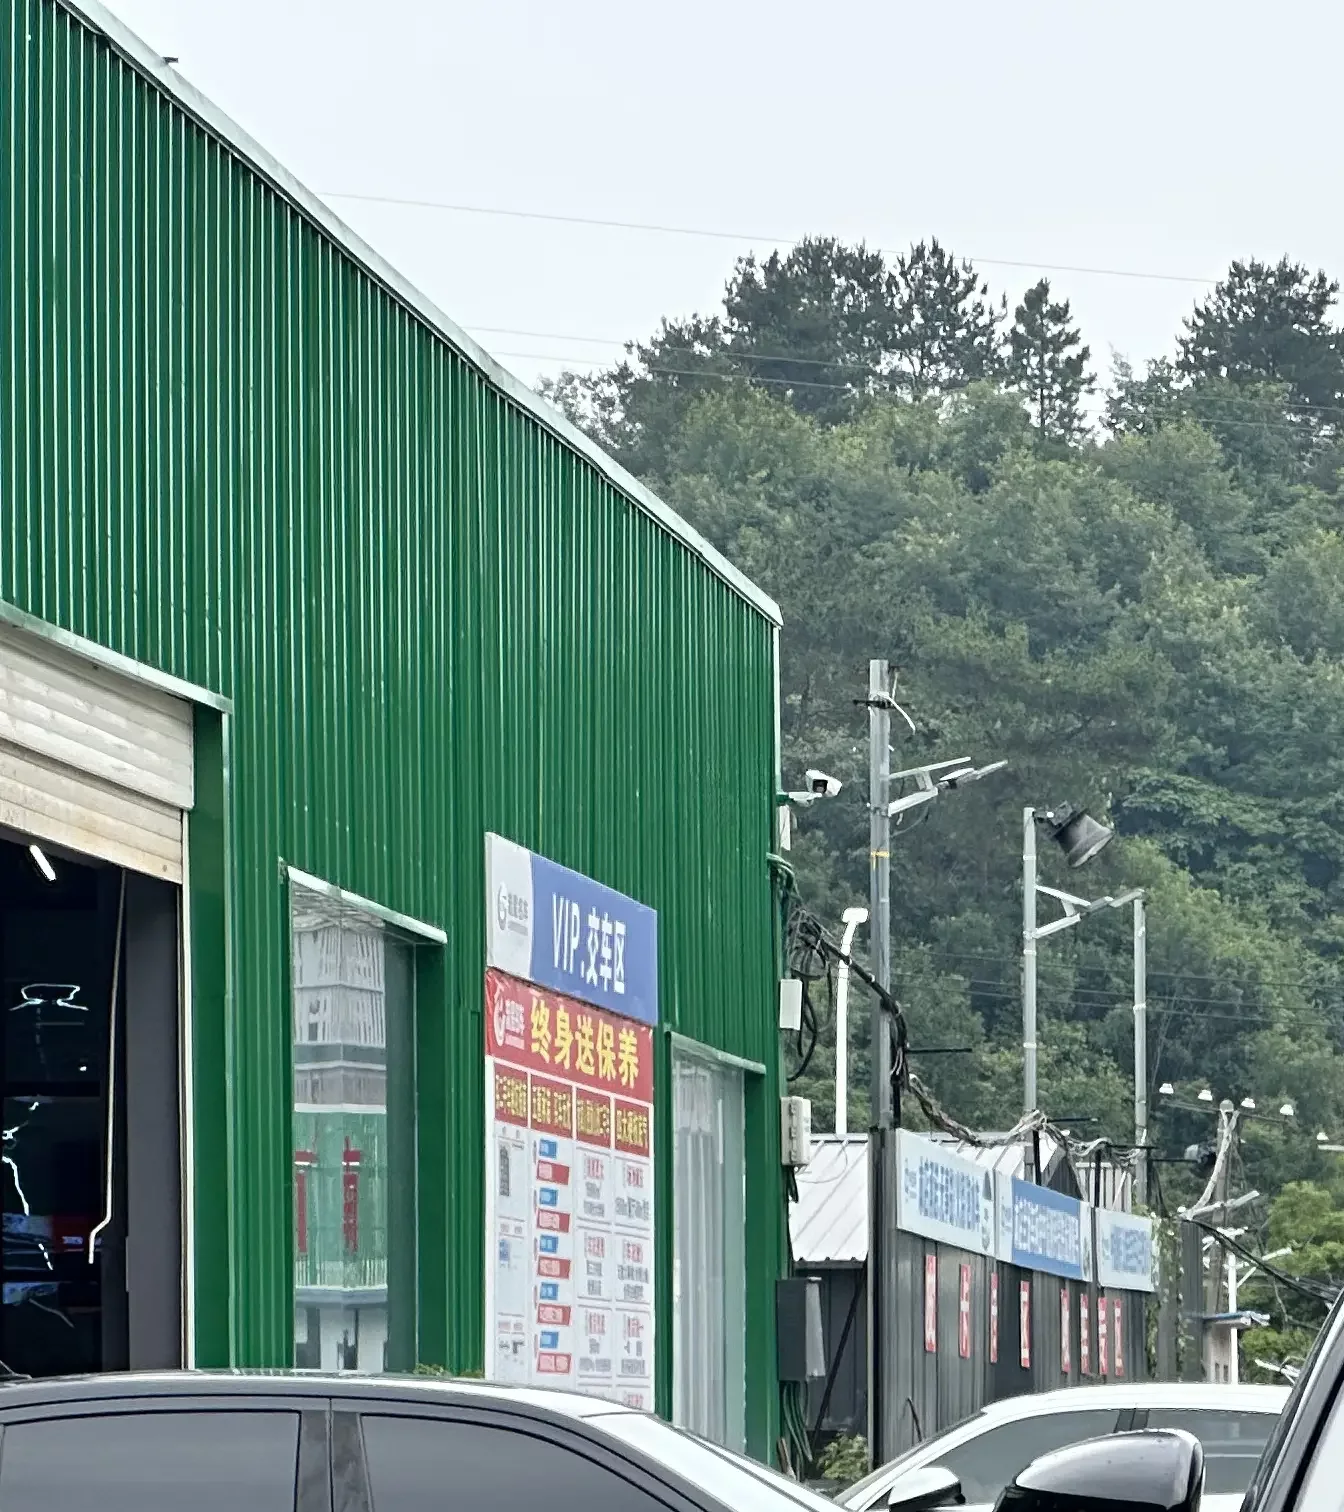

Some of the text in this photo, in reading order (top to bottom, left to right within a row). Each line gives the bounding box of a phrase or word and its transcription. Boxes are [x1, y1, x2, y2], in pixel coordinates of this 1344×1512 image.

[531, 996, 639, 1089] 终身送保养
